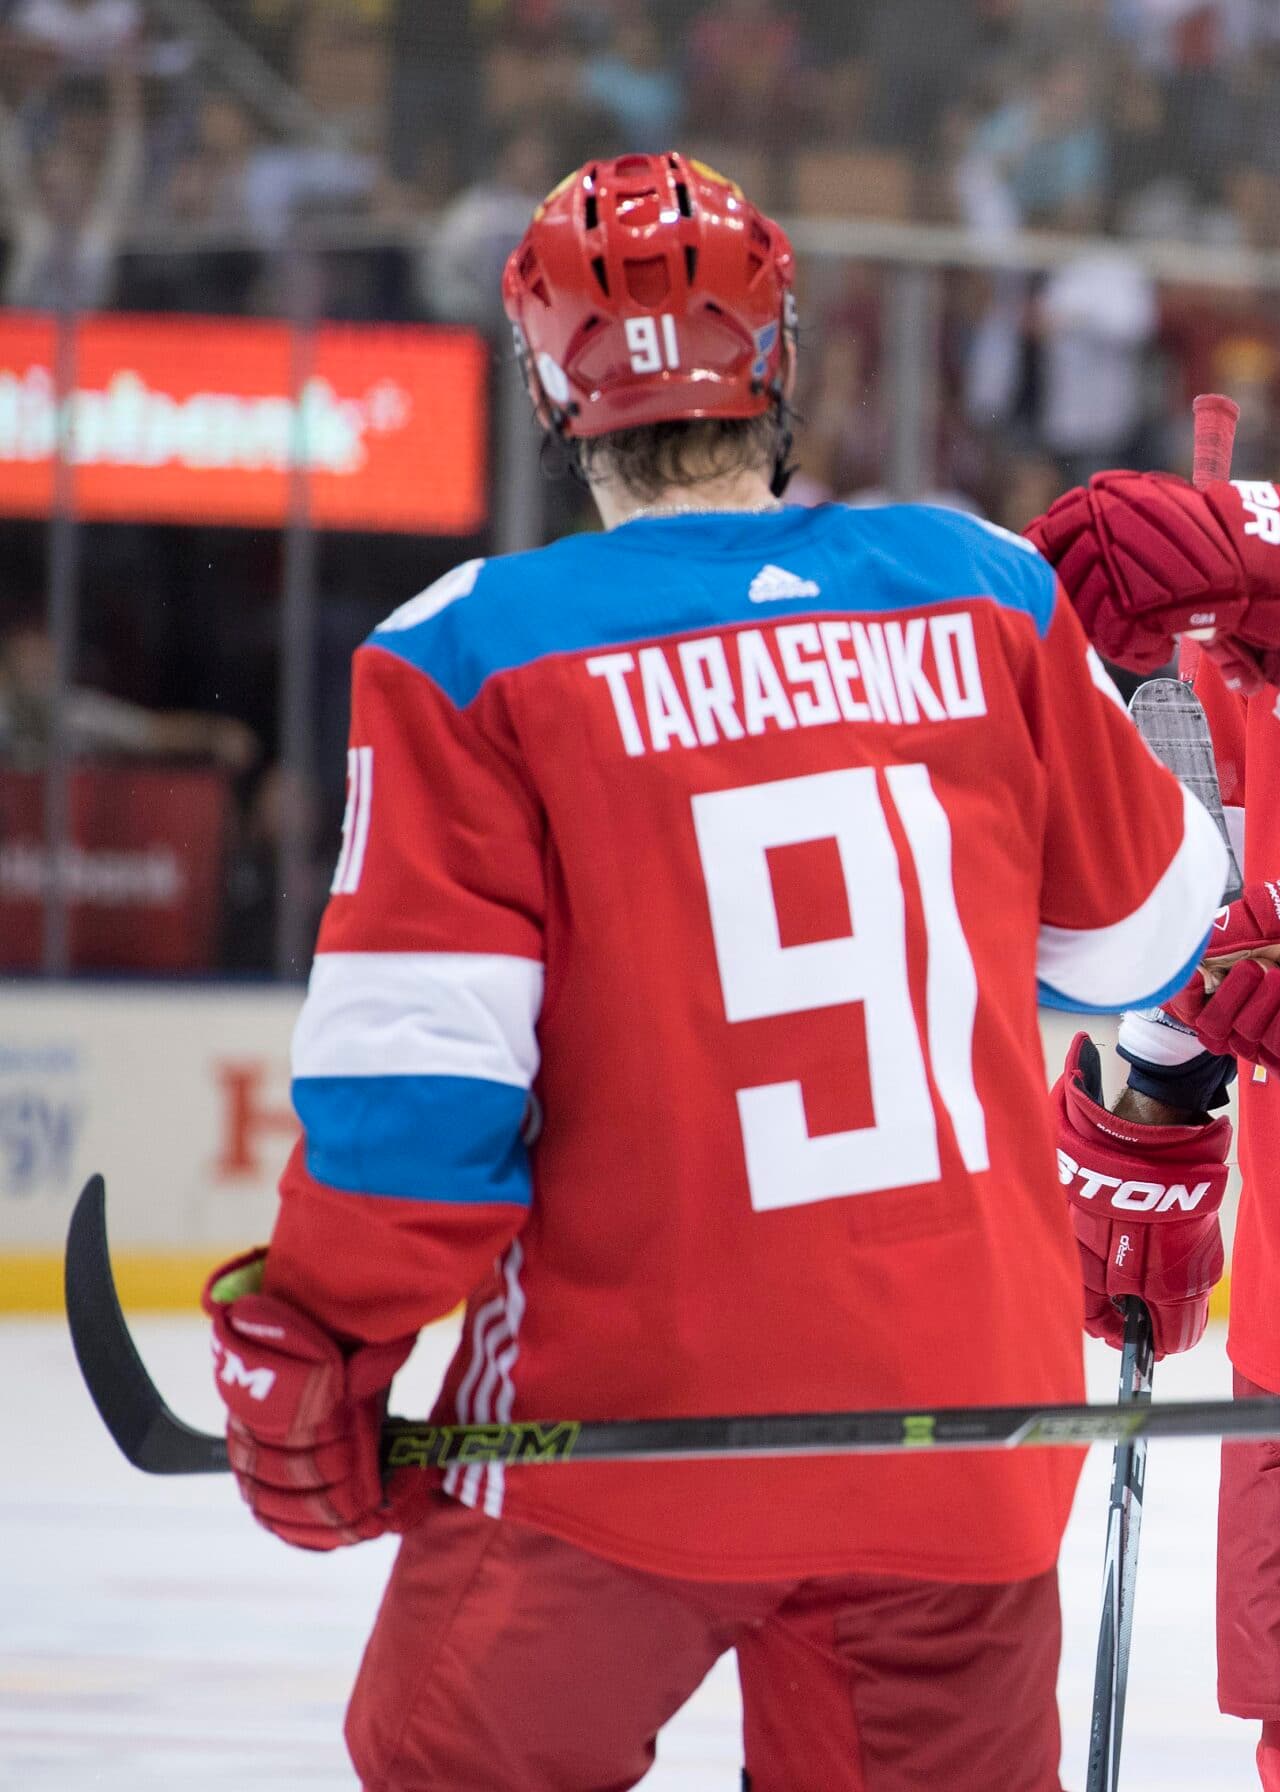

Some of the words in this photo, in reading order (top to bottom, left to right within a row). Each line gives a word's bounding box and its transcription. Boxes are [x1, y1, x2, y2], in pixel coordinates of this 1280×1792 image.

[624, 313, 680, 374] 91
[586, 611, 988, 757] TARASENKO
[690, 763, 990, 1213] 91
[387, 1420, 581, 1470] CCM
